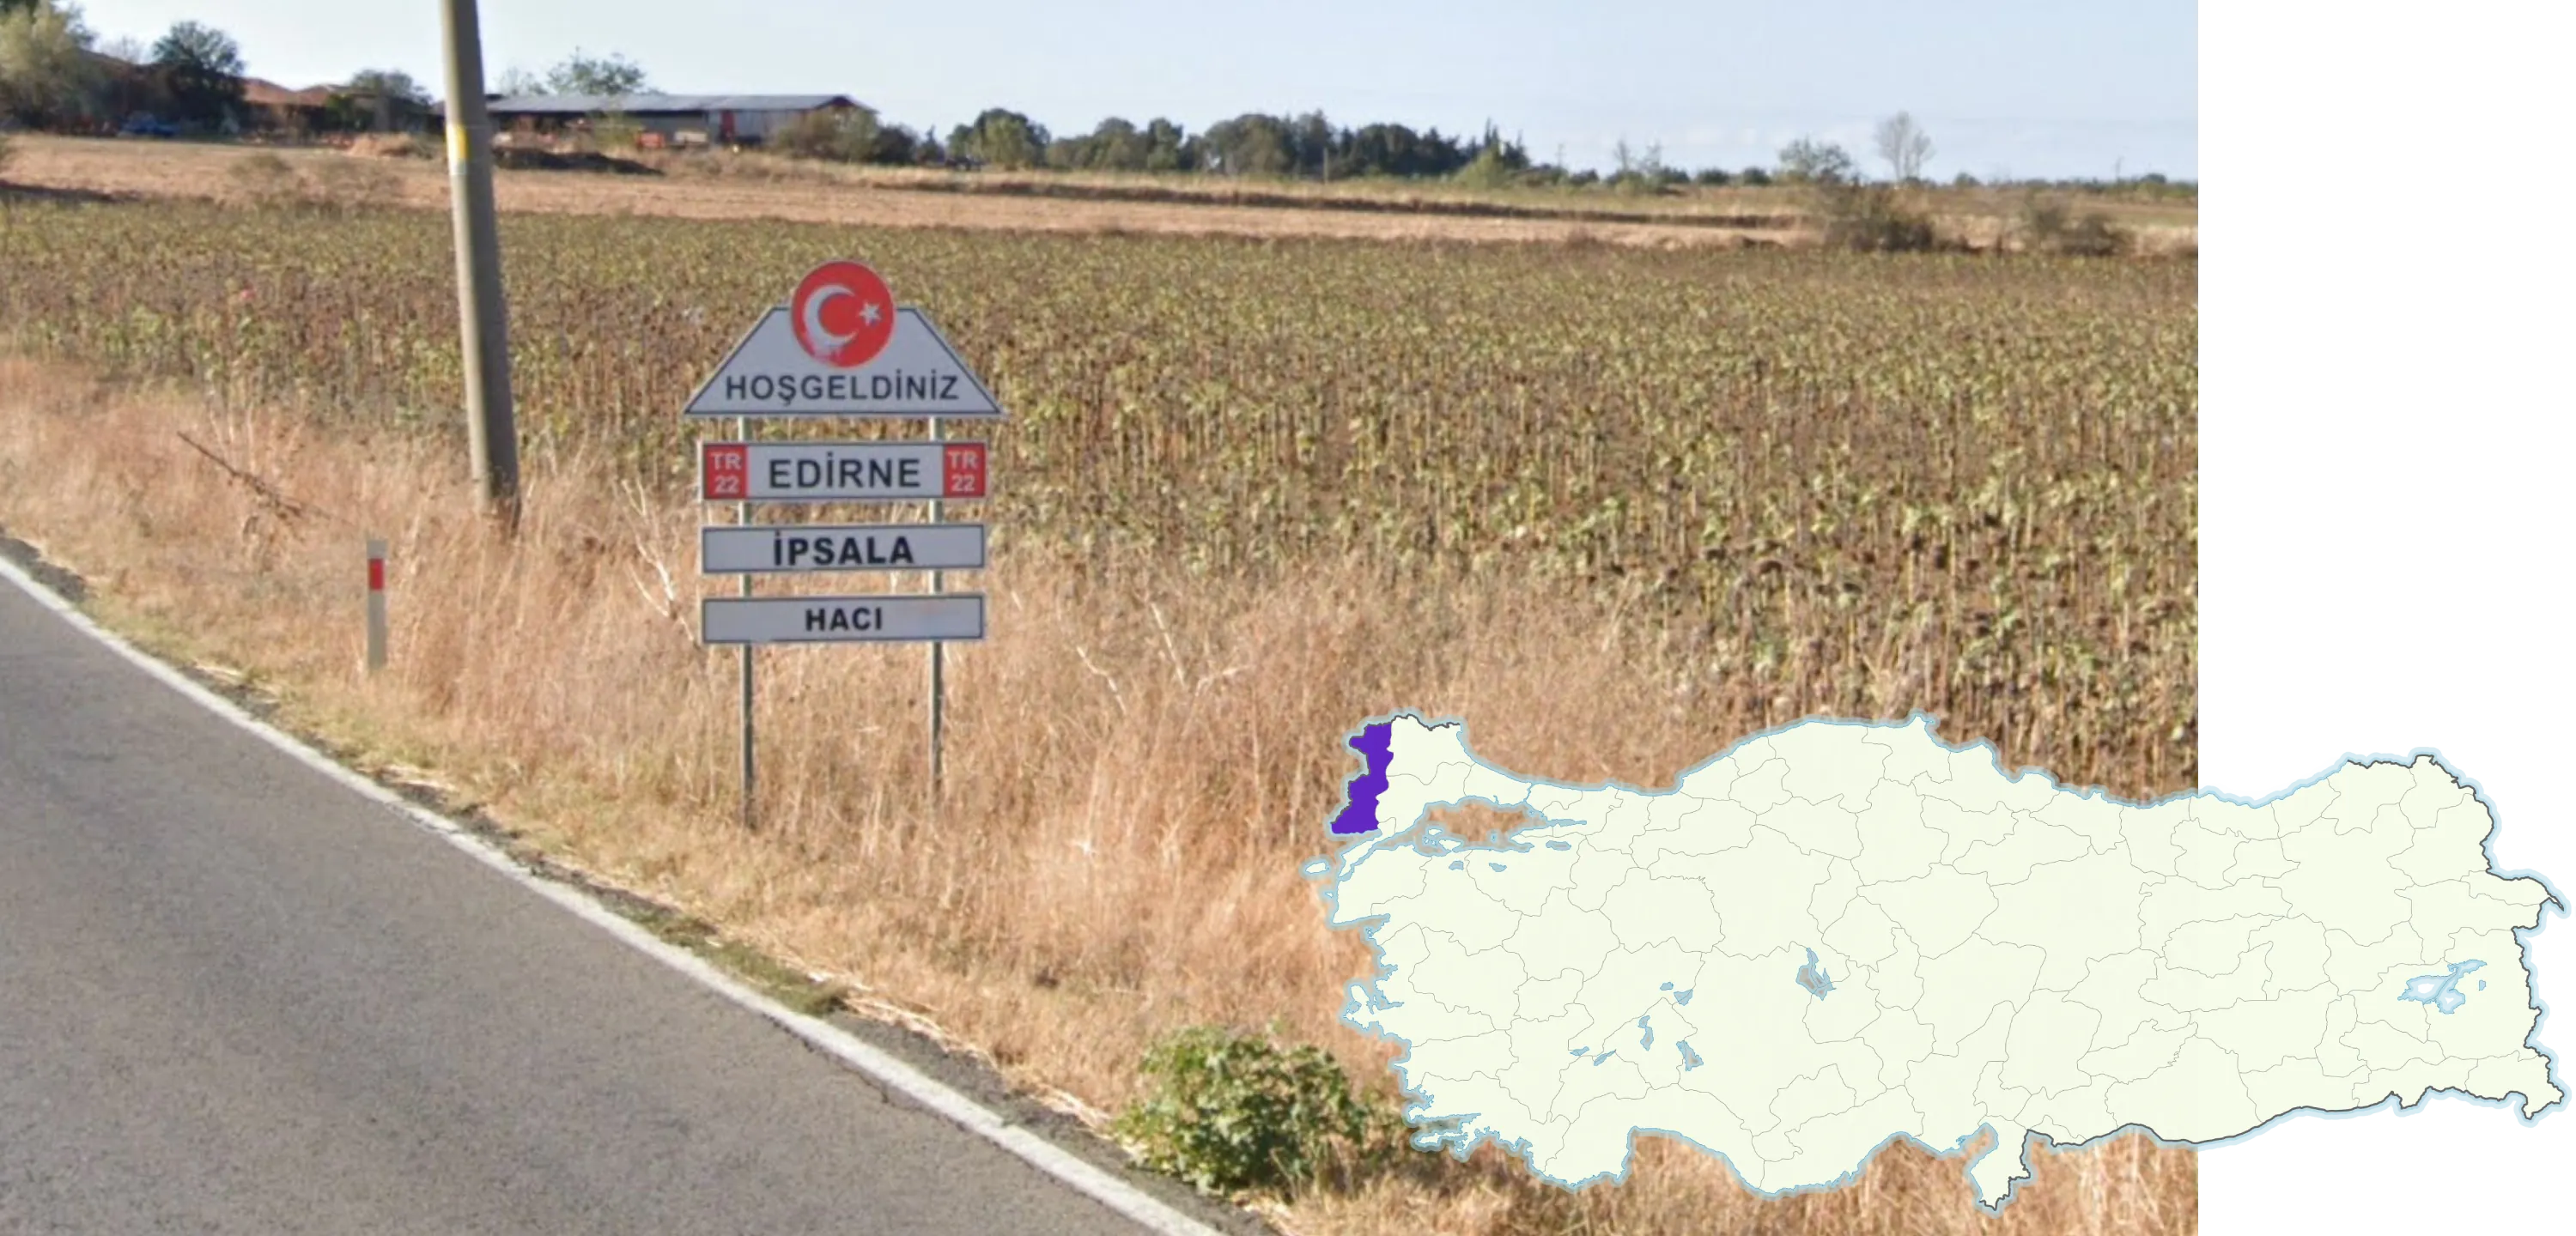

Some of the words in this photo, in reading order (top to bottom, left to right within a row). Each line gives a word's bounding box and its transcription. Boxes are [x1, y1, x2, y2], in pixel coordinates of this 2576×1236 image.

[726, 369, 959, 406] HOŞGELDİNİZ
[710, 453, 741, 470] TR
[769, 452, 921, 489] EDİRNE
[948, 451, 978, 469] TR
[714, 476, 739, 494] 22
[951, 475, 975, 493] 22
[773, 530, 914, 566] İPSALA
[805, 608, 883, 632] HACI
